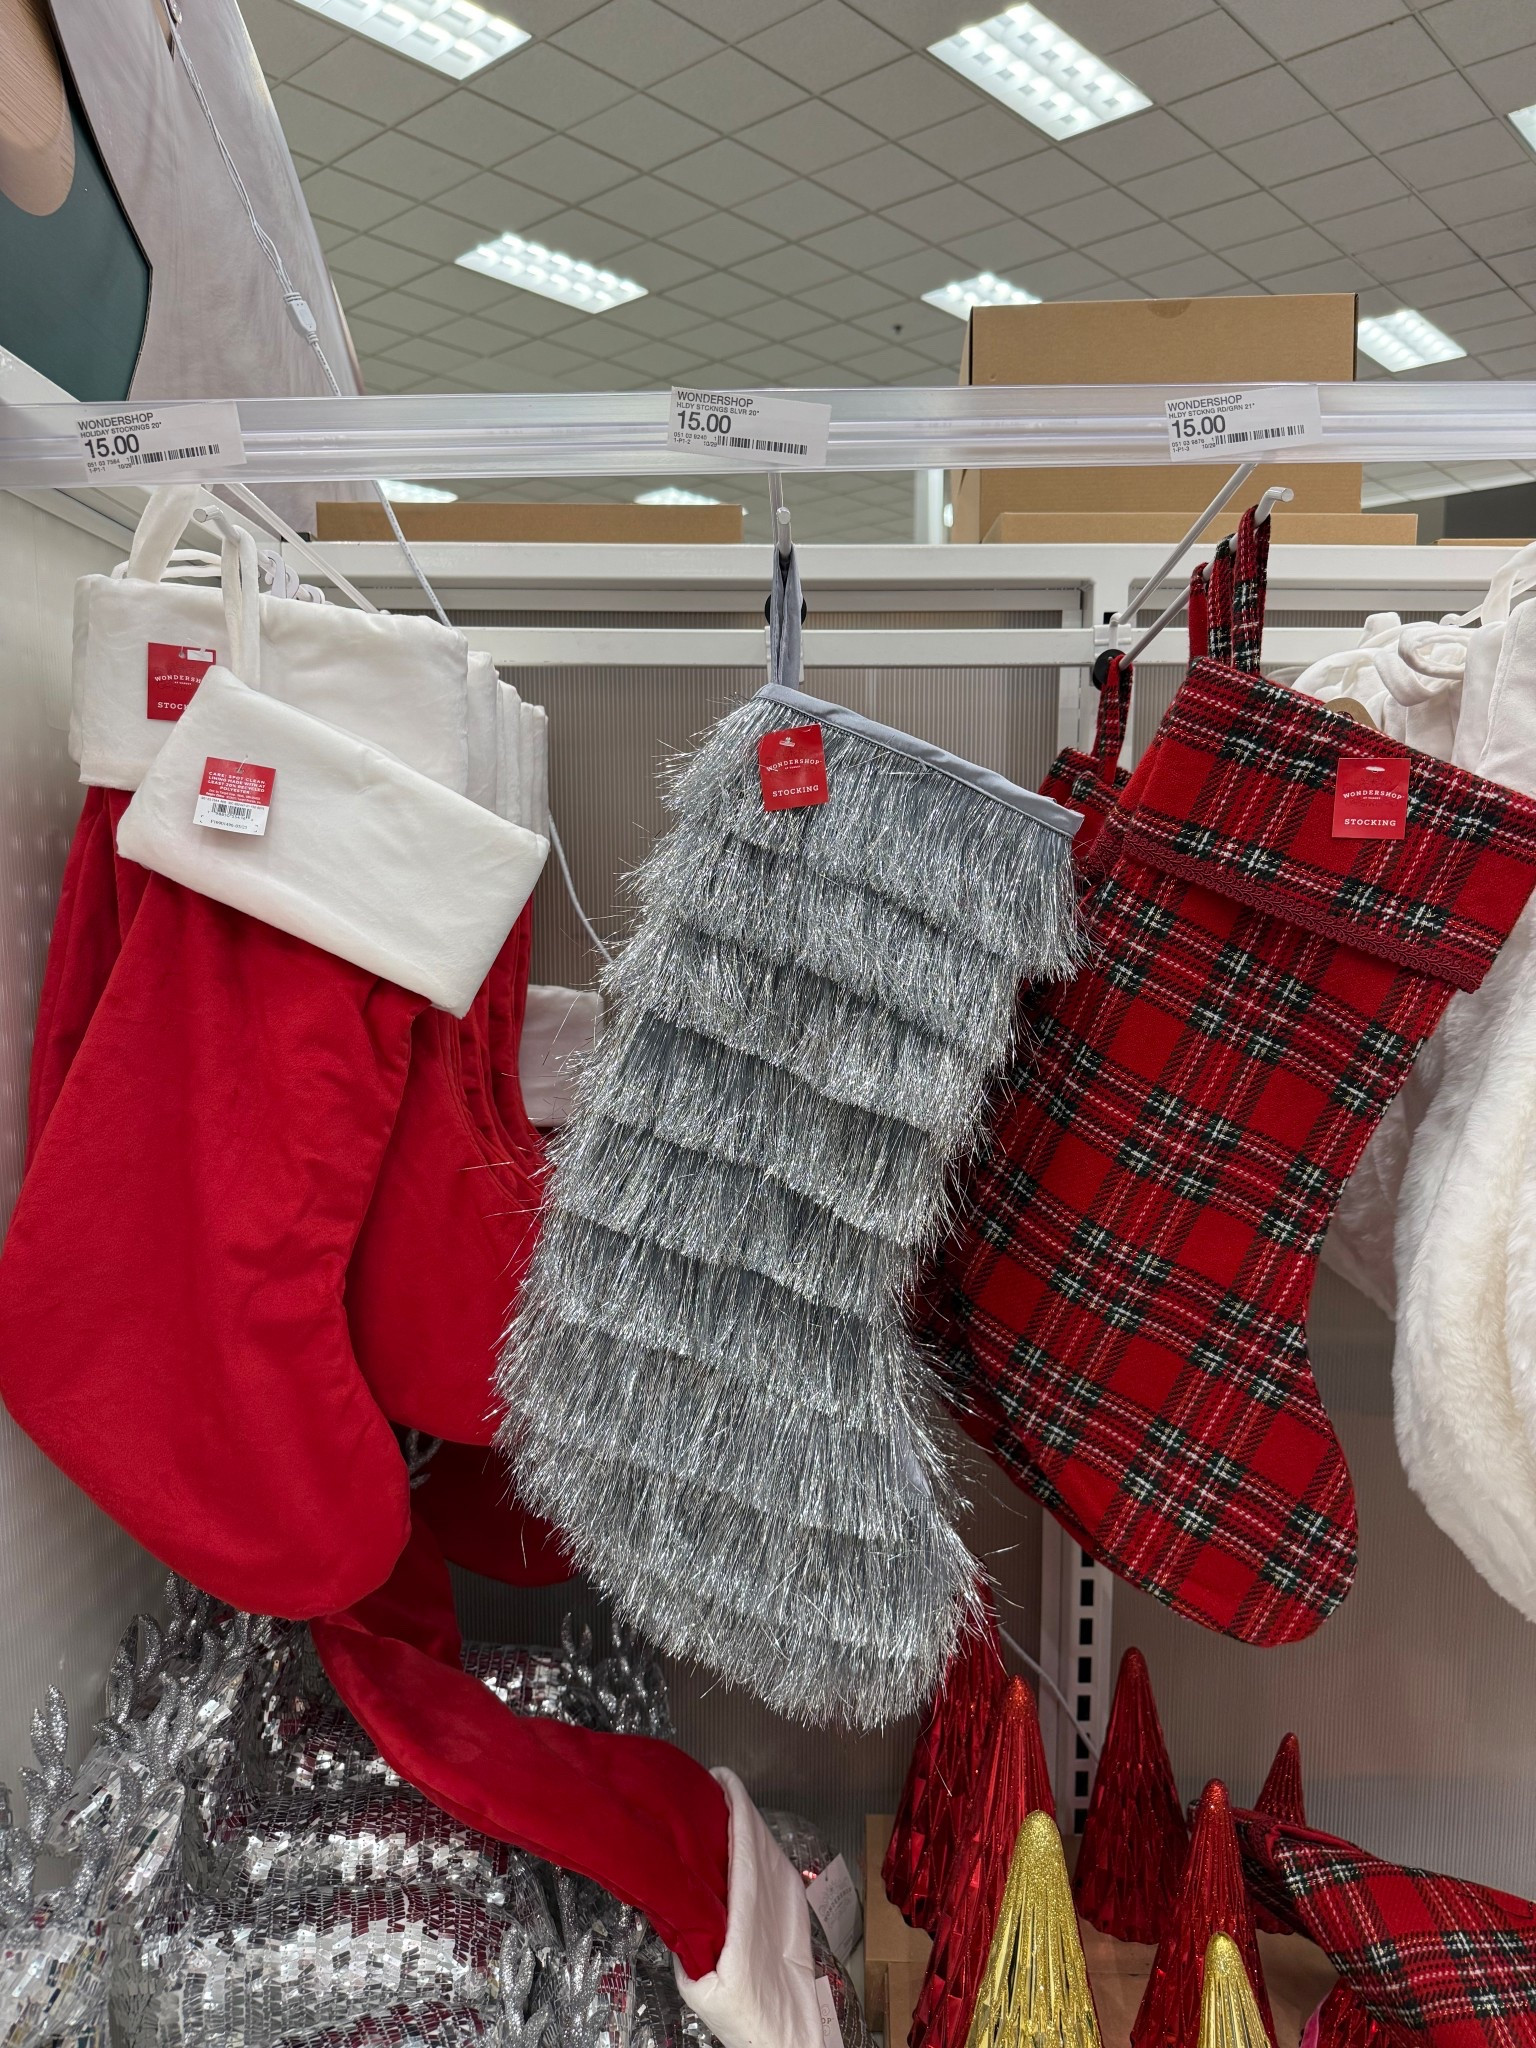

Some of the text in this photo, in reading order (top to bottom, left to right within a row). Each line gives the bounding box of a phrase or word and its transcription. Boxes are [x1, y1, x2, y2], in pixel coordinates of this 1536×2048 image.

[677, 391, 754, 408] WONDERSHOP
[1167, 395, 1243, 412] WONDERSHOP
[696, 404, 729, 413] STCKNGS
[730, 407, 747, 415] SLVR
[1168, 411, 1187, 419] HLDY
[1188, 408, 1216, 417] STCKNG
[1217, 404, 1243, 413] RD/GRN
[77, 412, 154, 431] WONDERSHOP
[677, 410, 732, 434] 15.00
[1171, 414, 1226, 439] 15.00
[80, 429, 110, 438] HOLIDAY
[111, 423, 150, 435] STOCKINGS
[84, 433, 140, 459] 15.00
[766, 758, 820, 772] WONDERSHOP
[772, 784, 819, 798] STOCKING
[1342, 789, 1403, 800] WONDERSHOP
[1344, 818, 1397, 827] STOCKING
